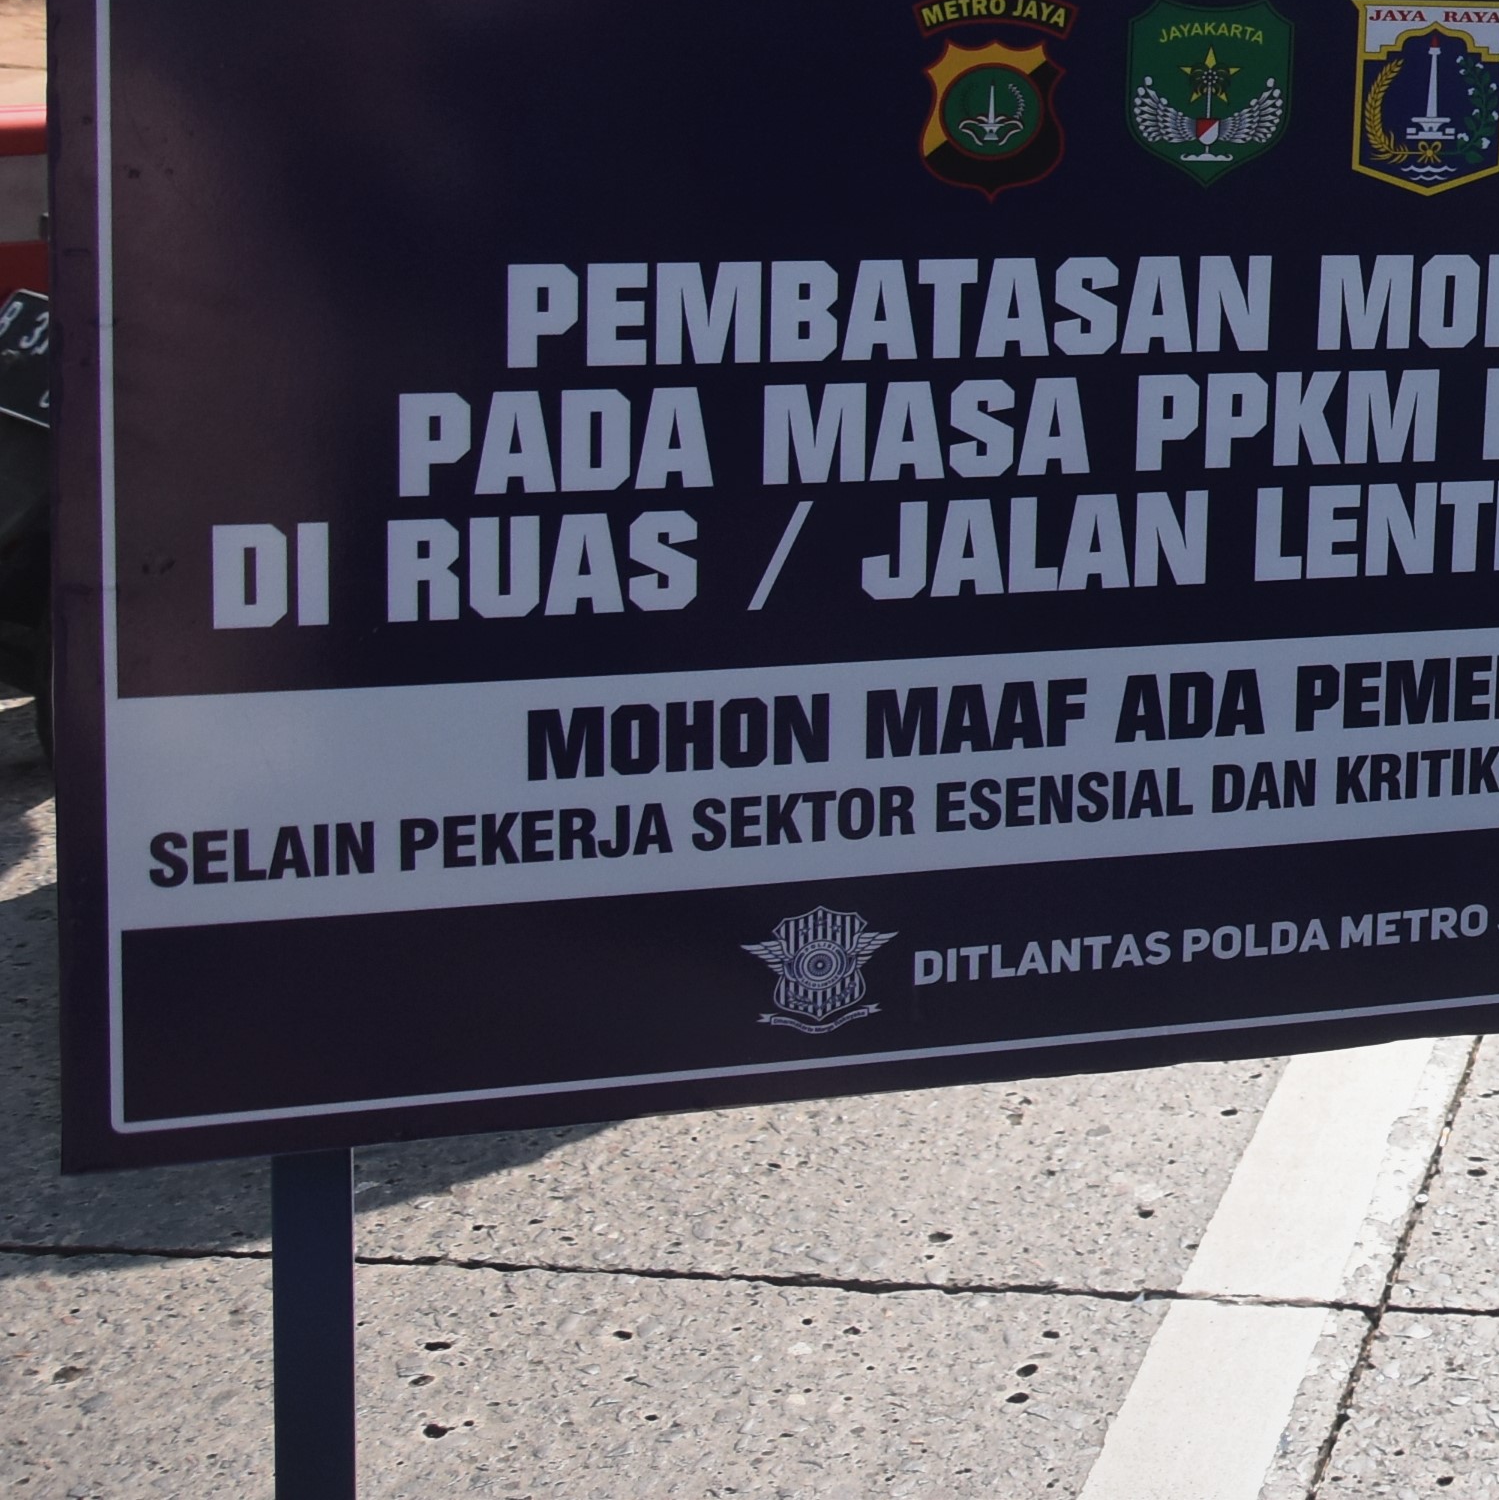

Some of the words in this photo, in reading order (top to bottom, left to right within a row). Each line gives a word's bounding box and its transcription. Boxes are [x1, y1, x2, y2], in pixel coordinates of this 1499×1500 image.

[1159, 21, 1264, 45] JAYAKARTA
[1369, 10, 1427, 22] JAYA
[507, 252, 1273, 369] PEMBATASAN
[399, 386, 714, 497] PADA
[762, 377, 1090, 485] MASA
[1135, 368, 1440, 472] PPKM
[212, 521, 330, 630] DI
[387, 510, 698, 623] RUAS
[747, 501, 814, 611] /
[861, 489, 1208, 601] JALAN
[527, 692, 830, 782] MOHON
[865, 677, 1088, 760] MAAF
[1114, 668, 1265, 744] ADA
[149, 821, 375, 888] SELAIN
[399, 802, 673, 872] PEKERJA
[691, 785, 916, 852] SEKTOR
[936, 767, 1194, 833] ESENSIAL
[1211, 759, 1317, 814] DAN
[914, 930, 1171, 986] DITLANTAS
[1182, 918, 1330, 963] POLDA
[1340, 904, 1488, 949] METRO
